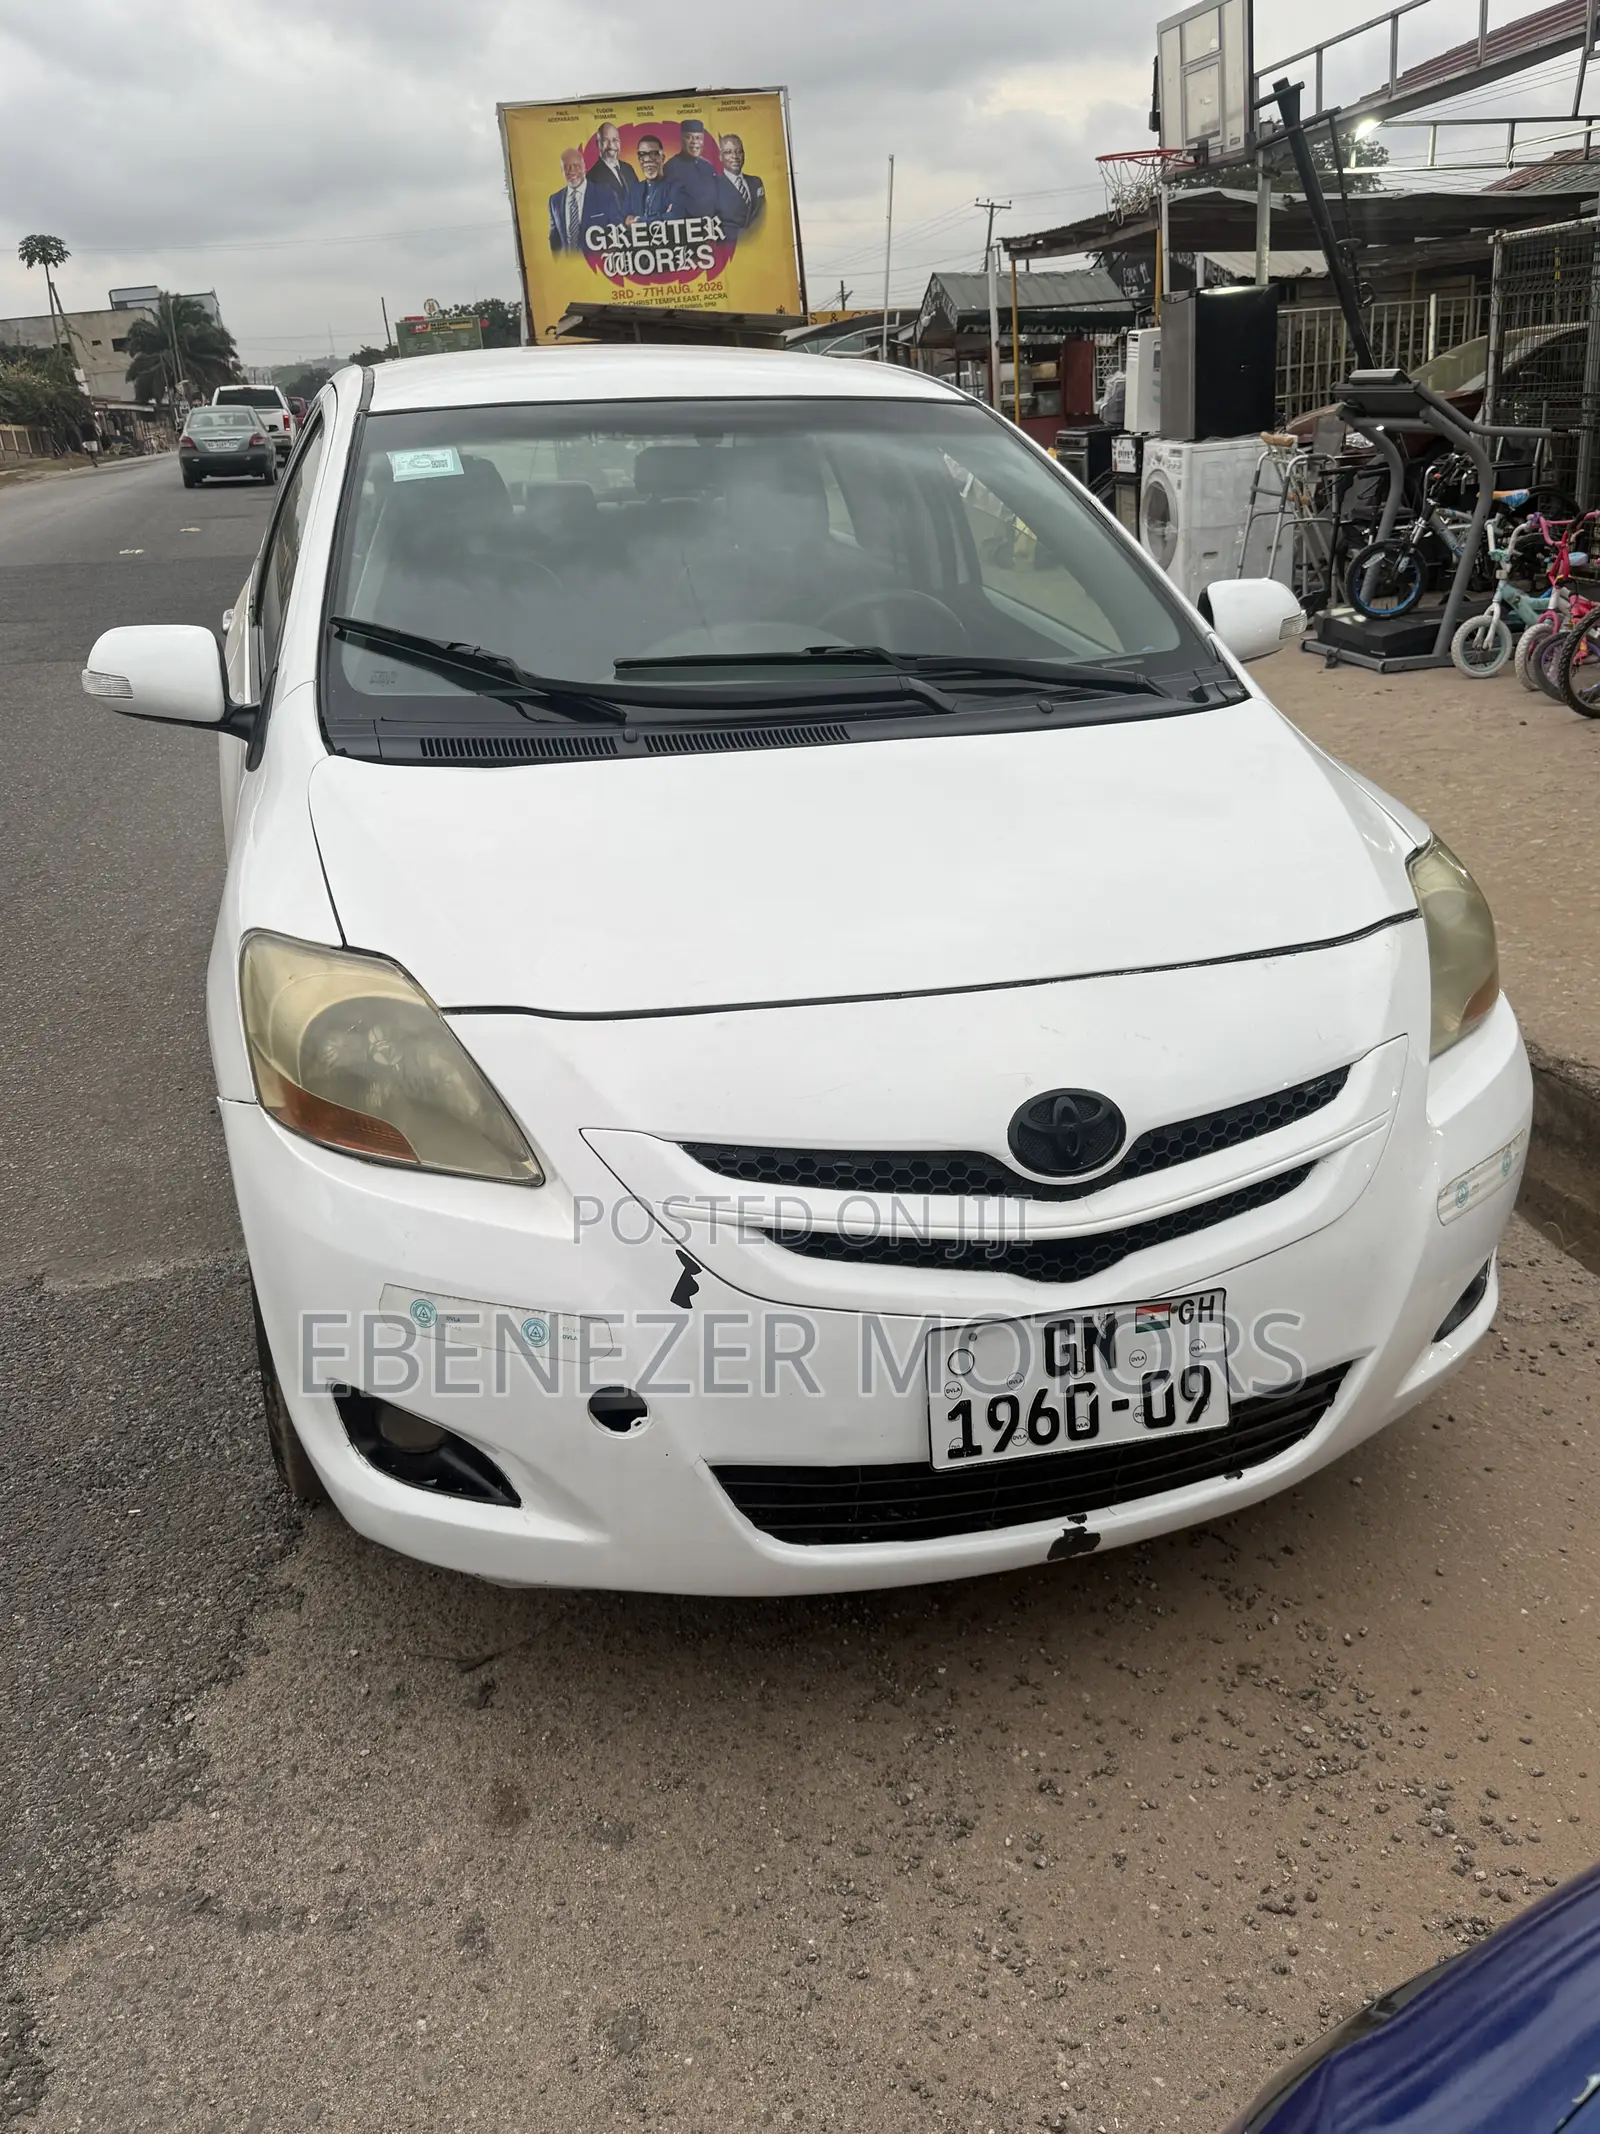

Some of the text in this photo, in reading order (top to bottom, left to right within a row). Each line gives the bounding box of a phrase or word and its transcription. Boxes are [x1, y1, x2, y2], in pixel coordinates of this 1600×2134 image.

[585, 215, 726, 251] GREATER
[601, 244, 715, 277] WORKS
[611, 289, 634, 300] 3RD
[643, 286, 664, 297] 7TH
[666, 284, 693, 295] AUG.
[698, 281, 723, 292] 2026
[654, 297, 681, 305] TEMPLE
[1179, 1295, 1215, 1325] GH
[1044, 1311, 1117, 1377] GN
[1131, 1355, 1145, 1363] DVLA
[947, 1364, 1212, 1459] 1960-09
